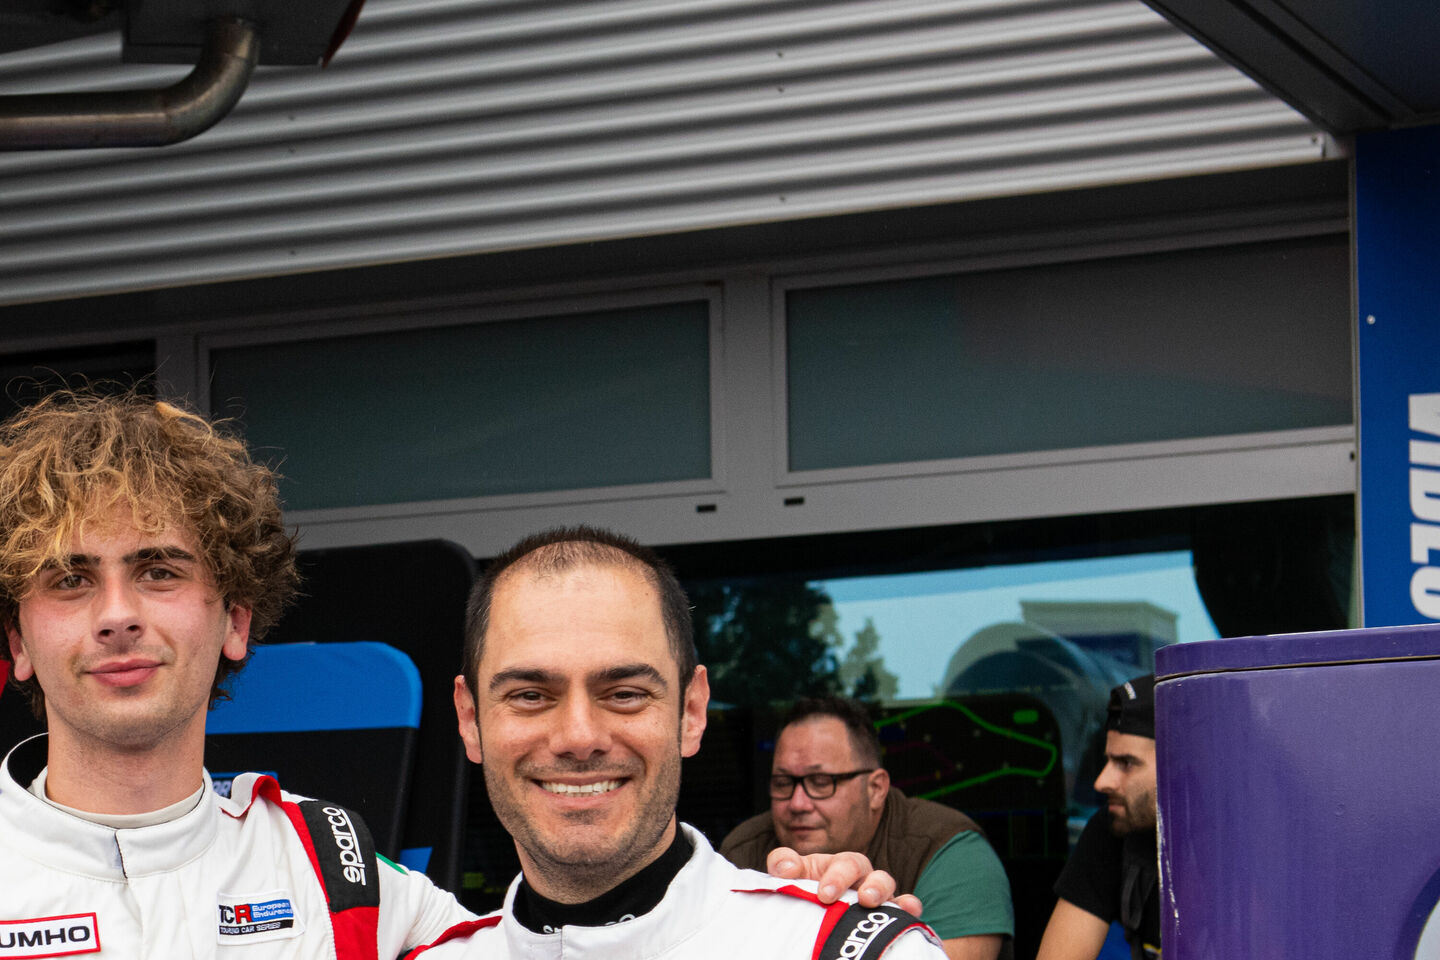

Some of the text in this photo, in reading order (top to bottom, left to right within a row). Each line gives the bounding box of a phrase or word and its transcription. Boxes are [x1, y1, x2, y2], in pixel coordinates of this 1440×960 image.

[323, 806, 367, 886] sparco
[218, 903, 252, 925] TCR
[241, 925, 255, 934] CAR
